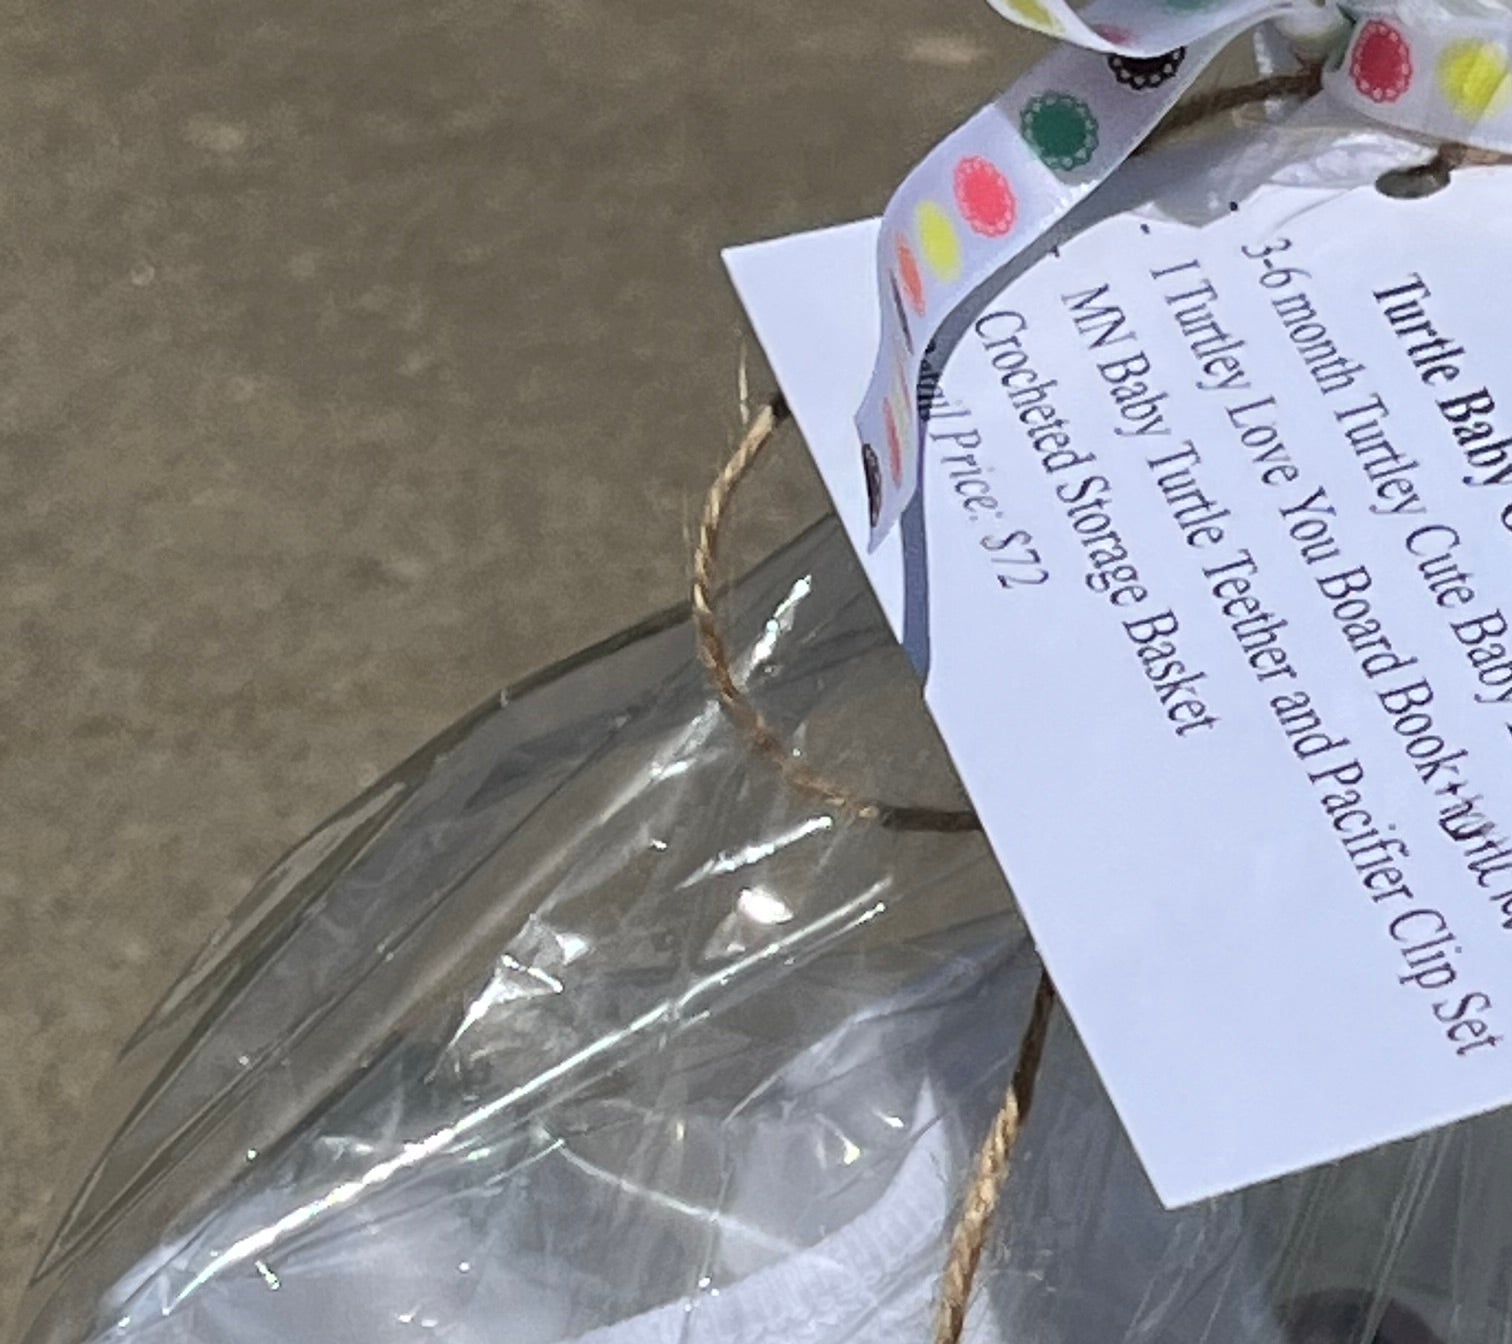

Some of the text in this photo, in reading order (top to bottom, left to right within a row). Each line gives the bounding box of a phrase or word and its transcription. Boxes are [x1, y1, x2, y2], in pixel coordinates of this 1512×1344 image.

[1241, 237, 1312, 289] 3-6
[1271, 293, 1366, 395] month
[1372, 272, 1466, 386] Turtle
[930, 429, 1003, 520] Price:
[980, 530, 1049, 589] $72
[1335, 392, 1427, 514] Turtley
[975, 311, 1221, 736] Crocheted Storage Basket
[1165, 278, 1252, 390] Turtley
[1224, 395, 1299, 486] Love
[1279, 485, 1341, 565] You
[1315, 564, 1418, 679] Board
[1376, 677, 1469, 784] Book
[1405, 524, 1475, 609] Cute
[1061, 283, 1503, 1056] MN Baby Turtle Teether and Pacifier Clip Set
